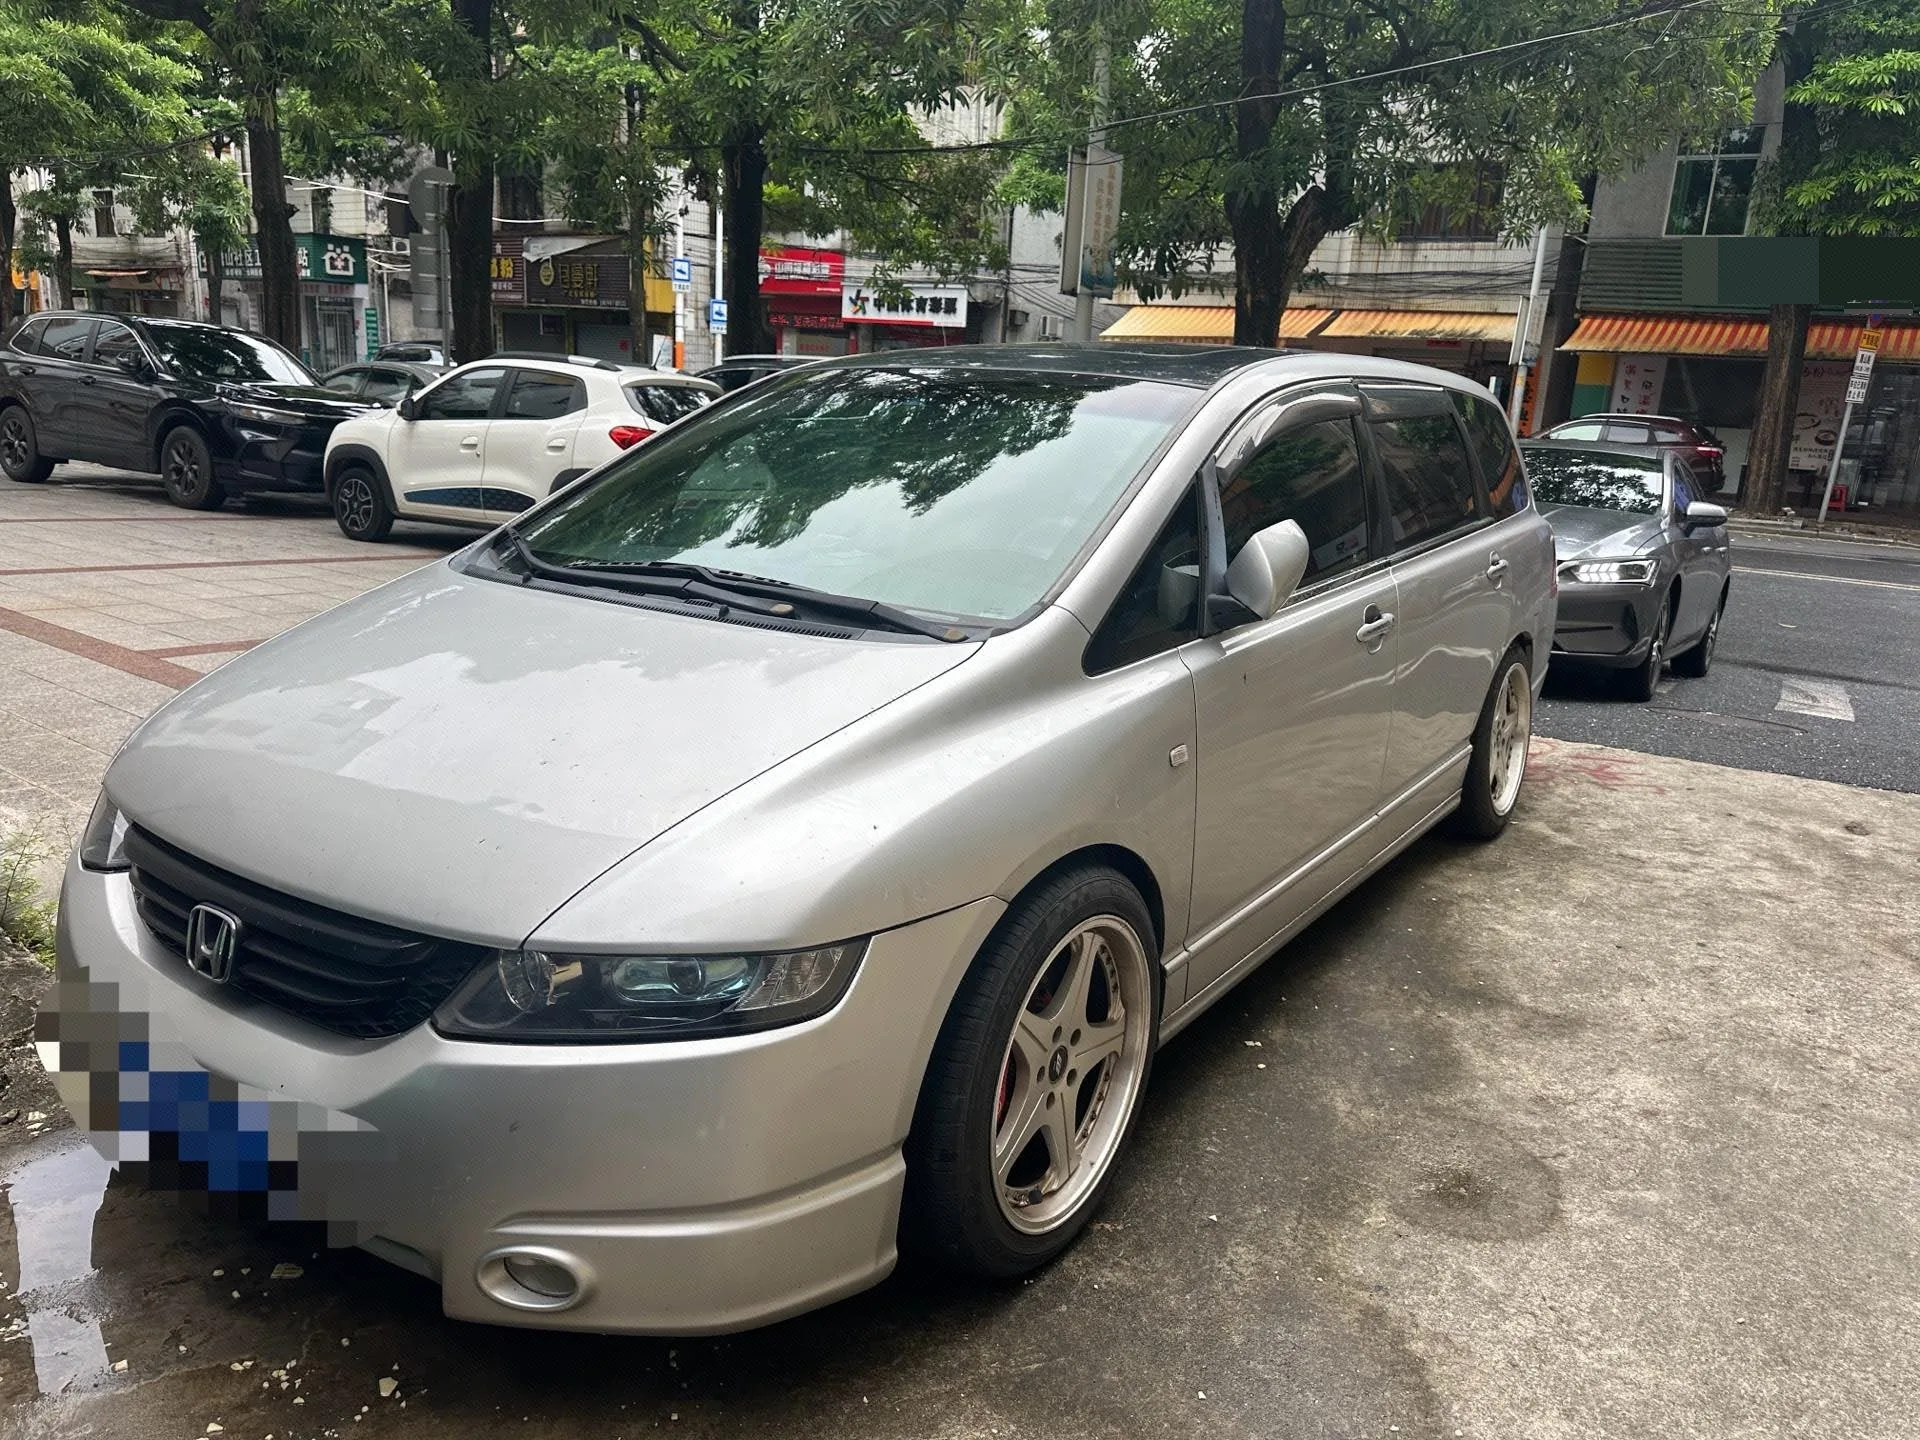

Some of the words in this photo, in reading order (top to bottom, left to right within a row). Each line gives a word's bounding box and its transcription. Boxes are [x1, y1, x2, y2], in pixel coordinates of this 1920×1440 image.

[873, 296, 957, 314] 中国体育彩票
